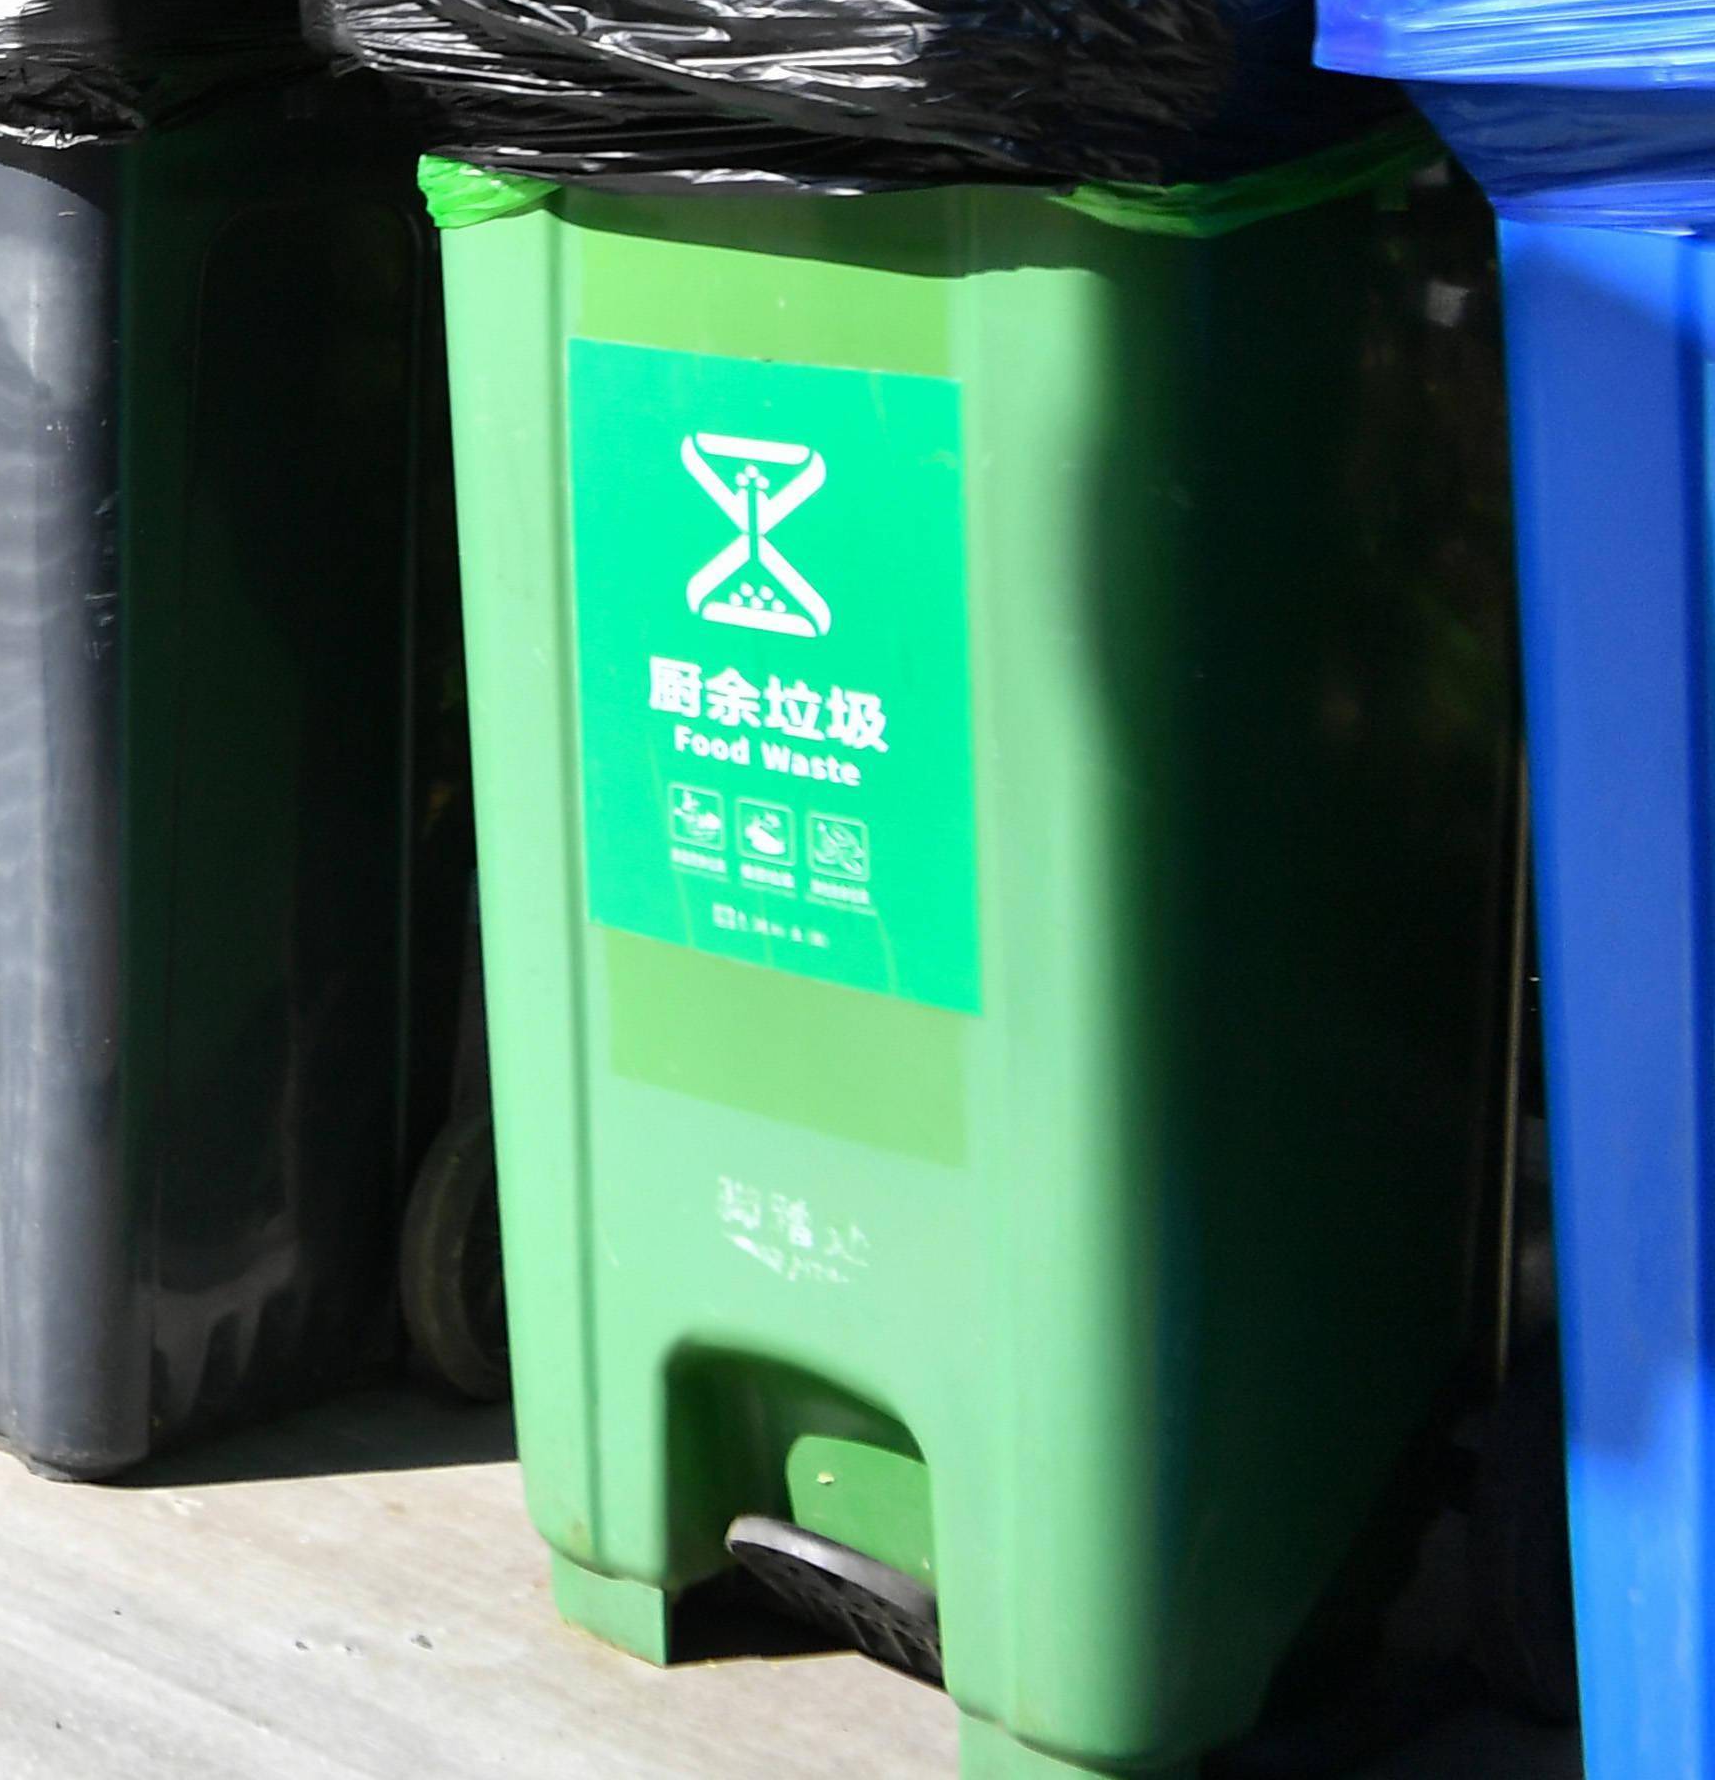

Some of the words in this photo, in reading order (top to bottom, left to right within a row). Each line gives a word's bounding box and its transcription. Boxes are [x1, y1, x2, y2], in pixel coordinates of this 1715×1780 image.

[649, 655, 890, 753] 厨余垃圾
[674, 725, 751, 766] Food
[760, 741, 862, 787] Waste
